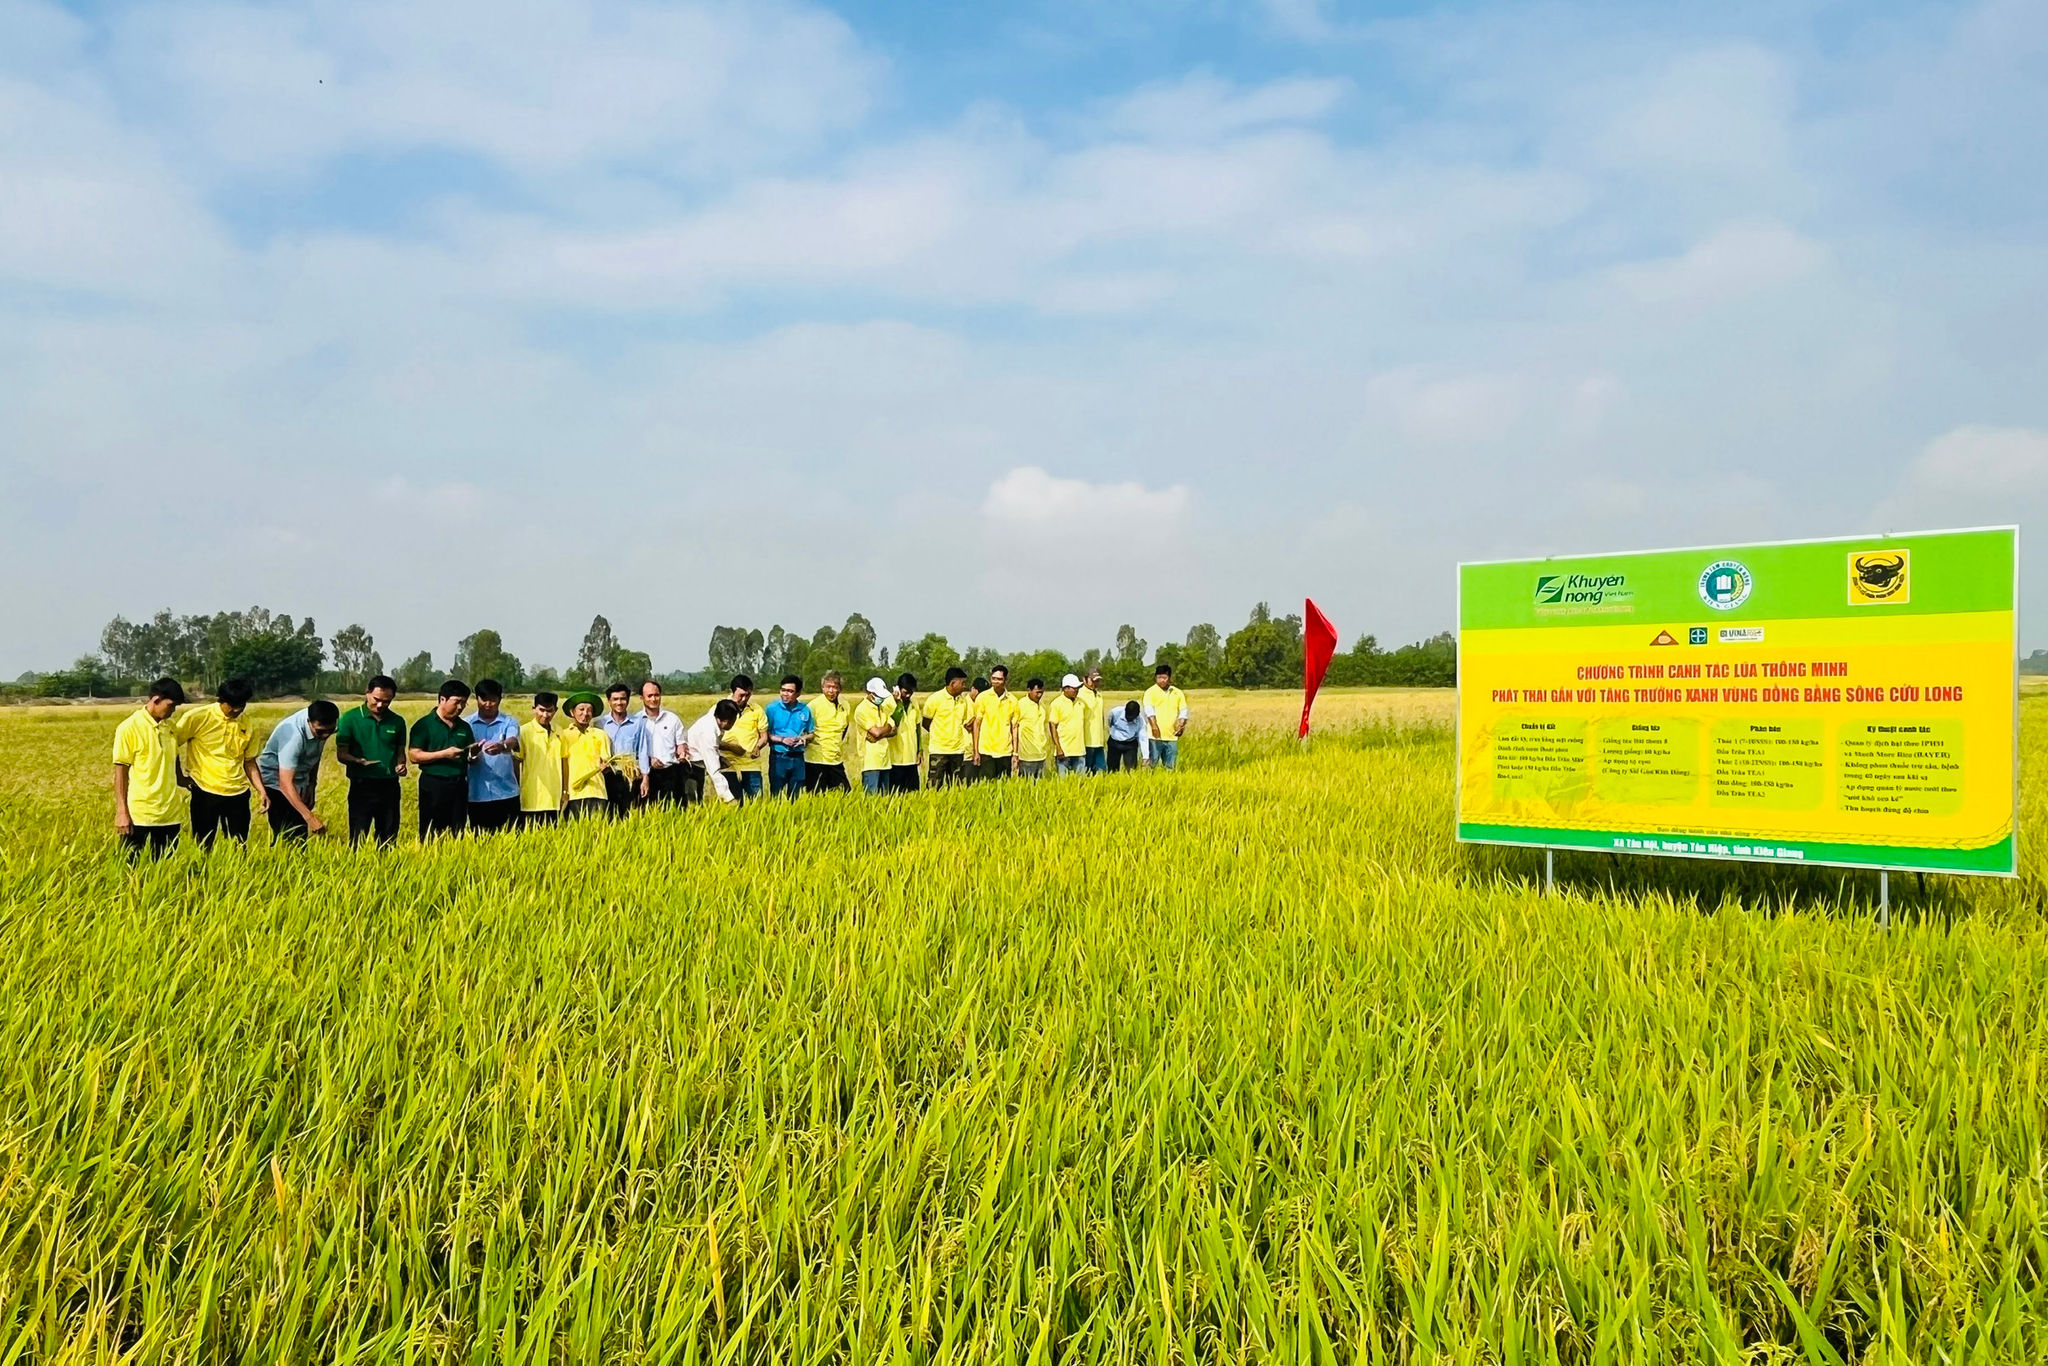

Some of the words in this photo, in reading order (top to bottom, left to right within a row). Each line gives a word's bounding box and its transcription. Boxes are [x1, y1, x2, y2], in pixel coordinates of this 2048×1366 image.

[1577, 664, 1624, 680] CHƯƠNG
[1628, 663, 1664, 679] TRÌNH
[1668, 664, 1701, 678] CANH
[1762, 660, 1806, 677] THÔNG
[1811, 662, 1848, 676] MINH
[1600, 687, 1630, 702] TĂNG
[1634, 686, 1682, 702] TRƯỞNG
[1686, 688, 1718, 702] XANH
[1846, 685, 1884, 702] SÔNG
[1924, 686, 1963, 702] LONG
